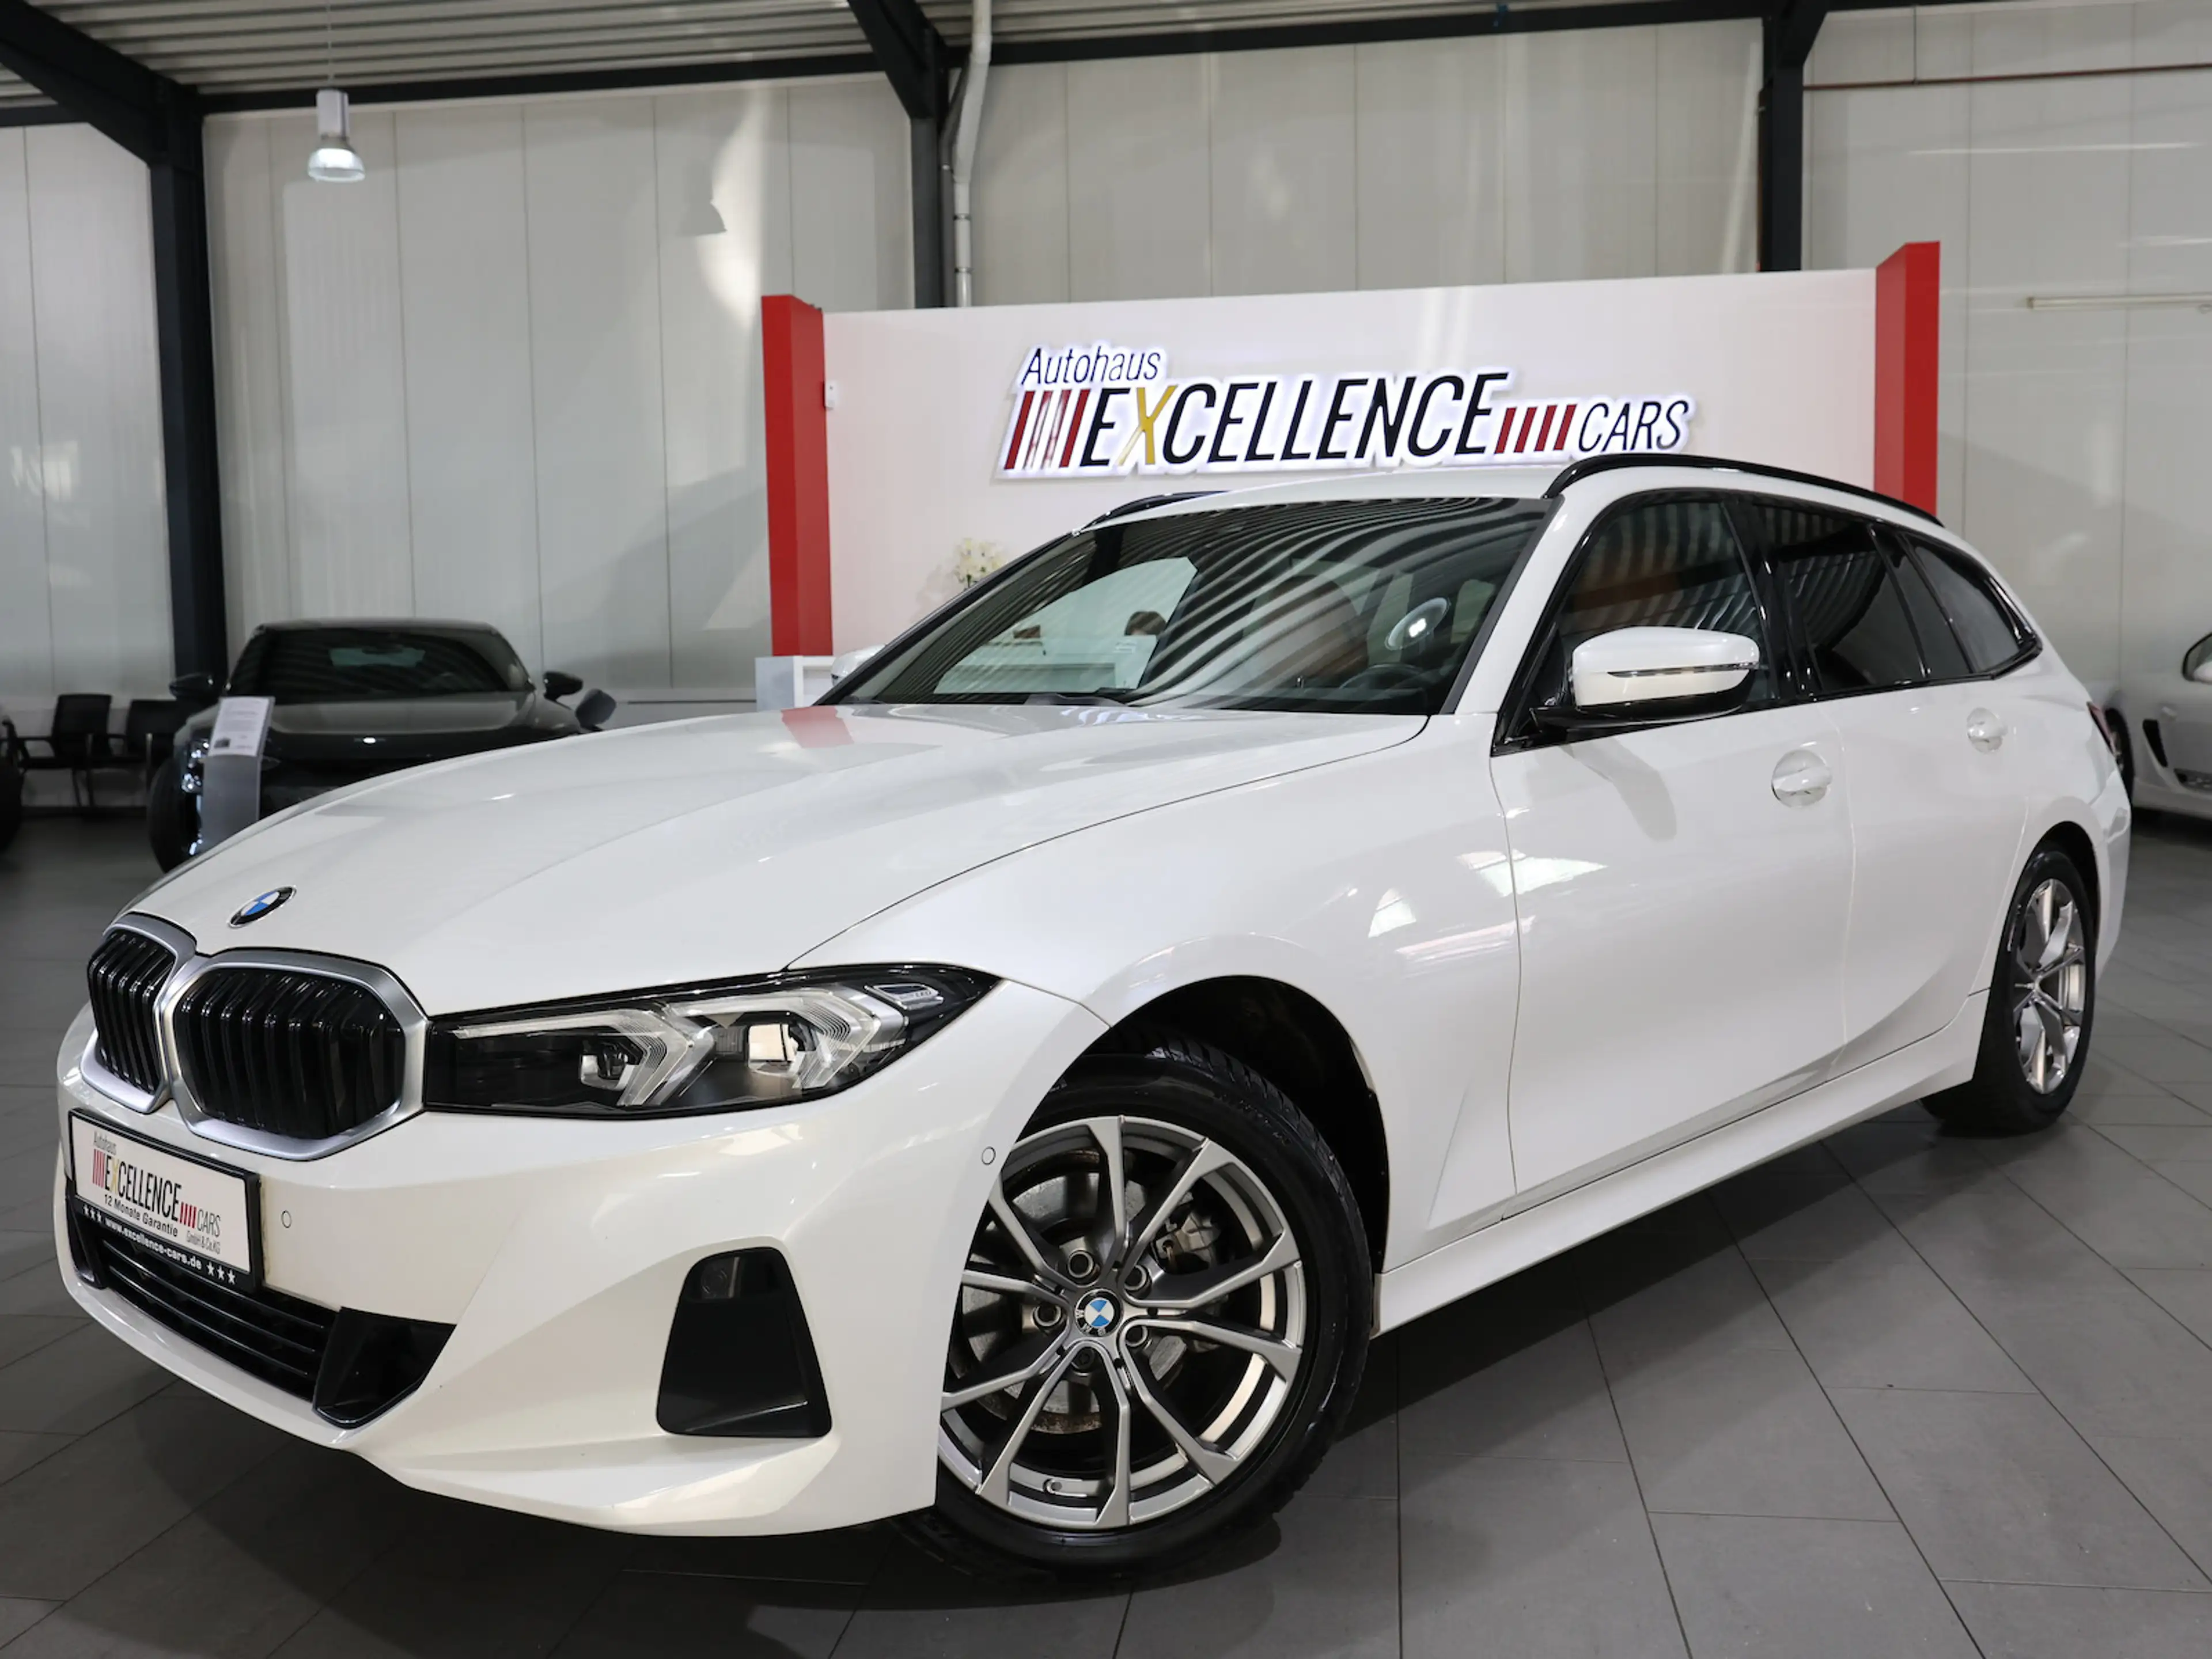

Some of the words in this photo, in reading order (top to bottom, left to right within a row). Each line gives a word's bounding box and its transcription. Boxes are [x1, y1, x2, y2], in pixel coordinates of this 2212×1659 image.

[1021, 346, 1161, 385] Autohaus
[1080, 372, 1508, 467] EXCELLENCE
[1578, 400, 1688, 451] CARS
[104, 1194, 113, 1207] 12
[114, 1199, 140, 1220] Monate
[142, 1213, 178, 1237] Garantie
[105, 1156, 181, 1221] EXCELLENCE
[197, 1209, 221, 1237] CARS
[105, 1218, 202, 1270] www.excellence-cars.de
